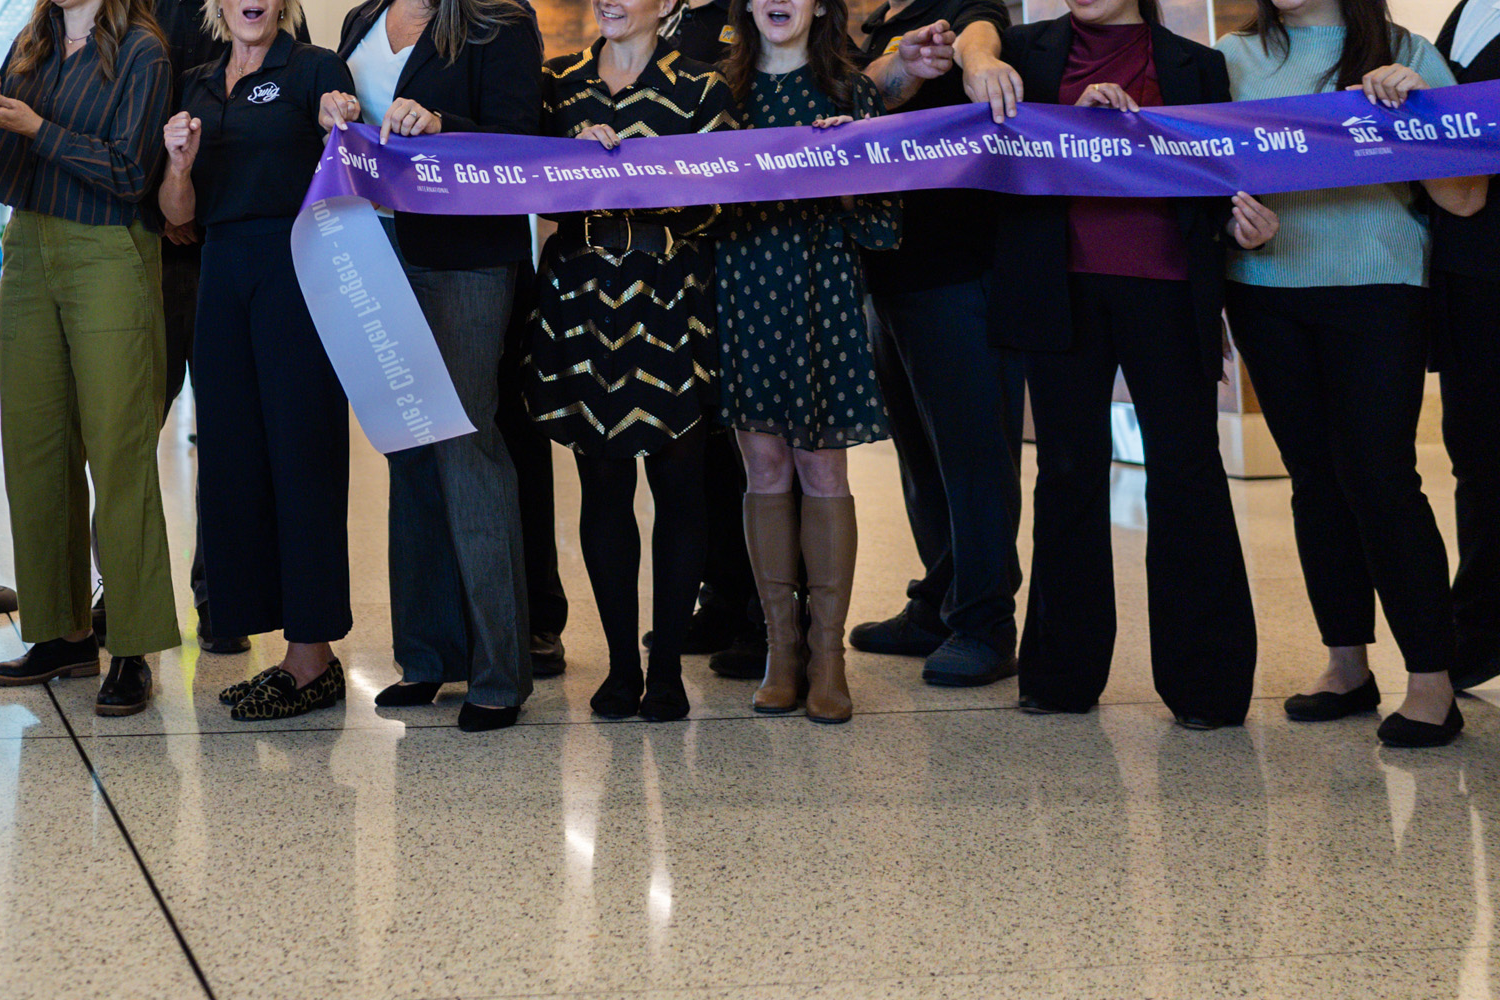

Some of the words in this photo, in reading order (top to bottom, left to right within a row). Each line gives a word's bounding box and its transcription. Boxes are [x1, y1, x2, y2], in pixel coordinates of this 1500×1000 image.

[247, 83, 280, 103] Swig
[1348, 126, 1384, 144] SLC
[1394, 119, 1437, 140] &Go
[1442, 112, 1480, 139] SLC
[338, 146, 379, 178] Swig
[454, 164, 490, 183] &Go
[494, 166, 526, 184] SLC
[545, 165, 620, 182] Einstein
[623, 163, 673, 176] Bros.
[675, 157, 739, 177] Bagels
[755, 144, 849, 170] Moochie's
[865, 142, 899, 164] Mr.
[900, 136, 982, 162] Charlie's
[985, 134, 1054, 157] Chicken
[1060, 134, 1132, 162] Fingers
[1149, 135, 1234, 156] Monarca
[1254, 127, 1308, 153] Swig
[414, 164, 443, 183] SLC
